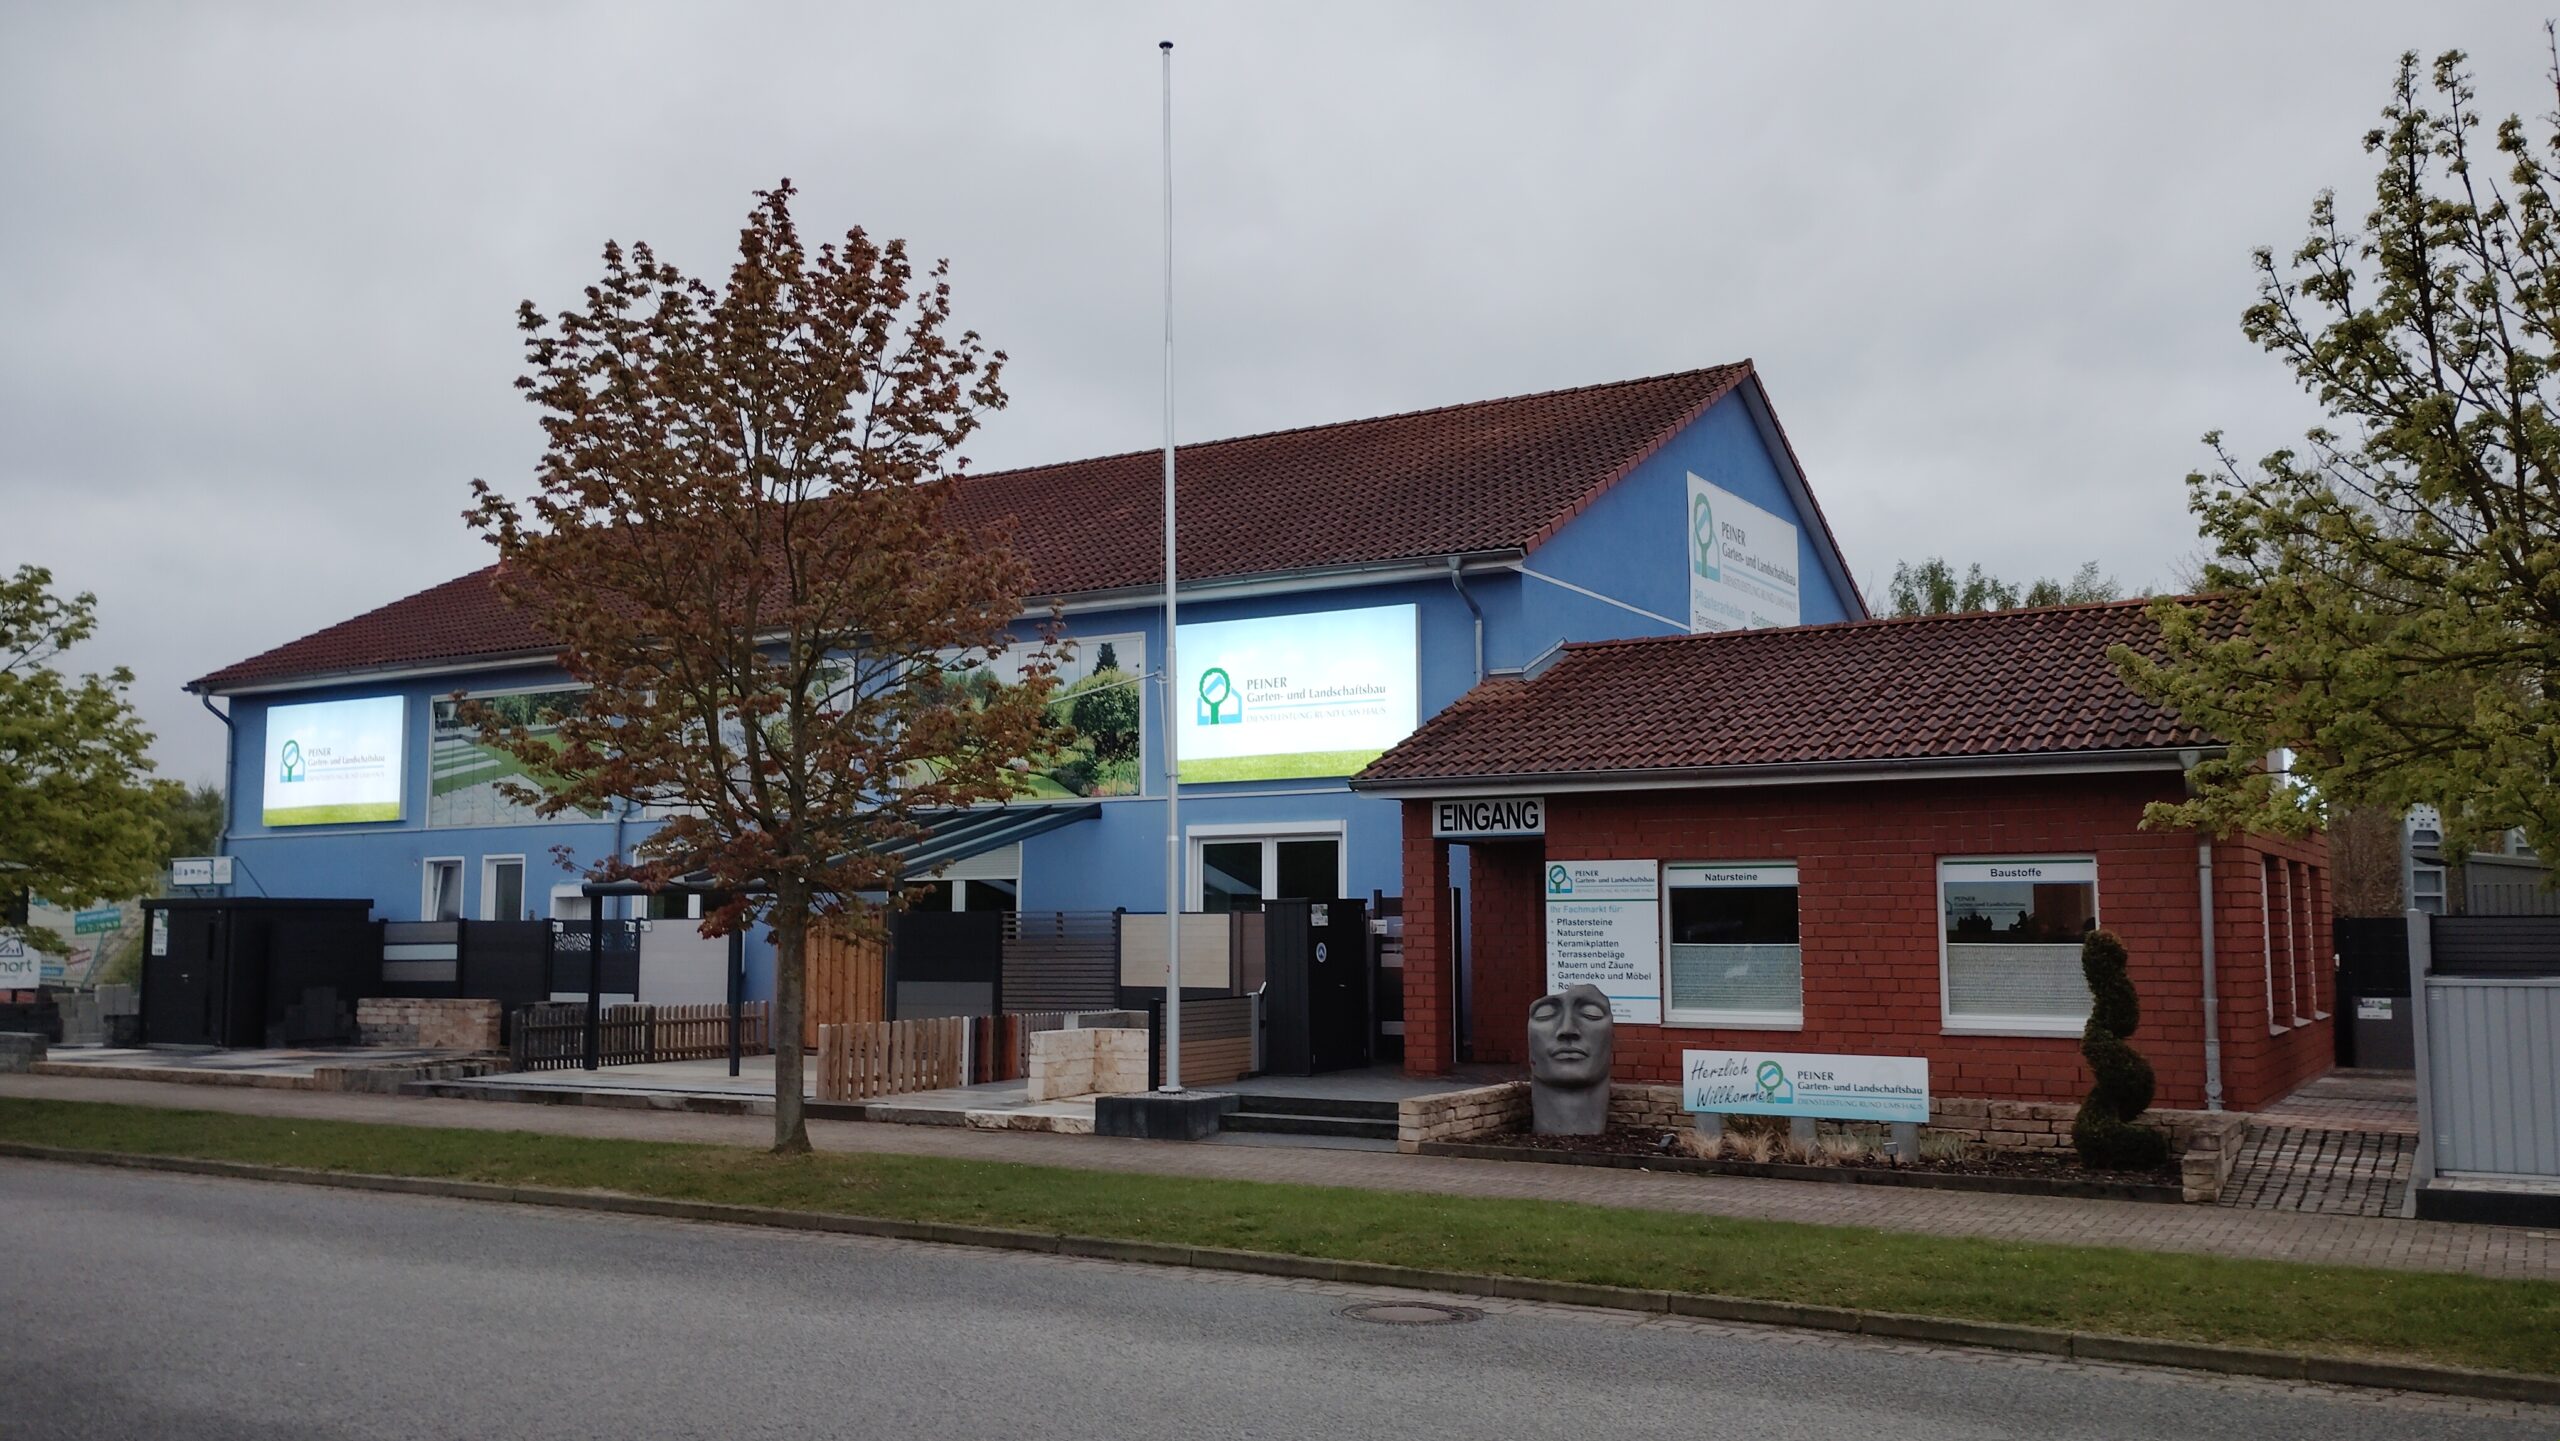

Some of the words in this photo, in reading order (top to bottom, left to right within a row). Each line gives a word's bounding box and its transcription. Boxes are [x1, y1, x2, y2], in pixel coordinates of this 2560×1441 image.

[1721, 521, 1746, 547] PEINER
[1721, 542, 1745, 561] Garten-
[1745, 554, 1757, 569] und
[1246, 676, 1288, 690] PEINER
[1246, 689, 1284, 703] Garten-
[1287, 687, 1306, 700] und
[1309, 684, 1387, 699] Landschaftsbau
[308, 747, 332, 757] PEINER
[1440, 801, 1539, 832] EINGANG
[1704, 873, 1758, 881] Natursteine
[1990, 867, 2042, 877] Baustoffe
[1550, 905, 1561, 913] Ihr
[1563, 905, 1607, 914] Fachmarkt
[1556, 918, 1613, 927] Pflastersteine
[1557, 929, 1604, 937] Natursteine
[1557, 940, 1619, 949] Keramikplatten
[1558, 950, 1625, 960] Terrassenbeläge
[1558, 961, 1588, 969] Mauern
[1590, 961, 1606, 969] und
[1608, 961, 1634, 969] Zäune
[1558, 971, 1605, 980] Gartendeko
[1607, 971, 1624, 980] und
[1626, 971, 1652, 980] Möbel
[1691, 1058, 1749, 1081] Herzlich
[1797, 1070, 1834, 1081] PEINER
[1797, 1081, 1831, 1092] Garten-
[1833, 1081, 1851, 1092] und
[1853, 1082, 1923, 1095] Landschaftsbau
[1696, 1082, 1774, 1108] Willkommen
